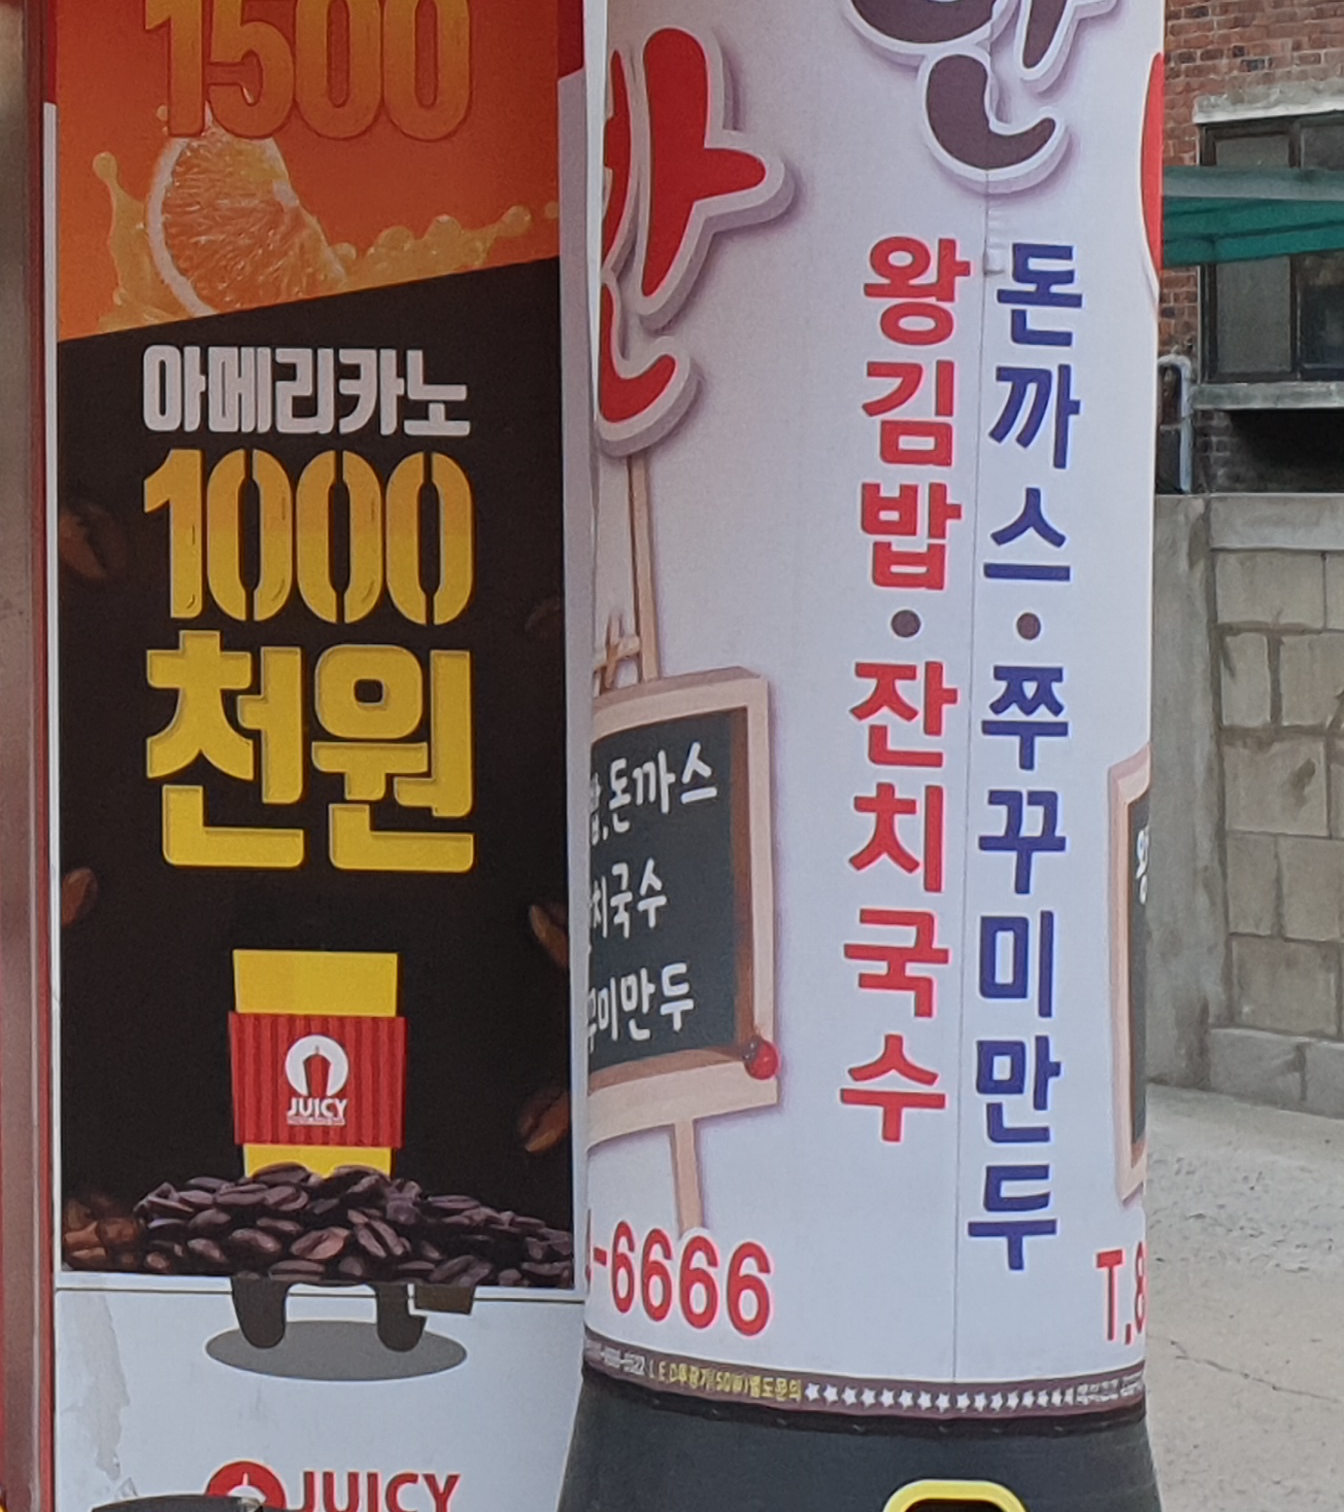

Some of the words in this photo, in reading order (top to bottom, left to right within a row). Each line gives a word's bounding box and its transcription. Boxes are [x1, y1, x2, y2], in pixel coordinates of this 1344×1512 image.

[142, 344, 471, 437] 아메리카노
[861, 235, 972, 591] 왕김밥
[982, 242, 1083, 583] 돈까스
[143, 448, 474, 626] 1000
[145, 630, 475, 874] 천원
[838, 660, 959, 1143] 잔치국수
[967, 664, 1071, 1272] 쭈꾸미만두
[286, 1096, 349, 1118] JUICY
[585, 1208, 772, 1337] -6666
[295, 1470, 462, 1512] JUICY
